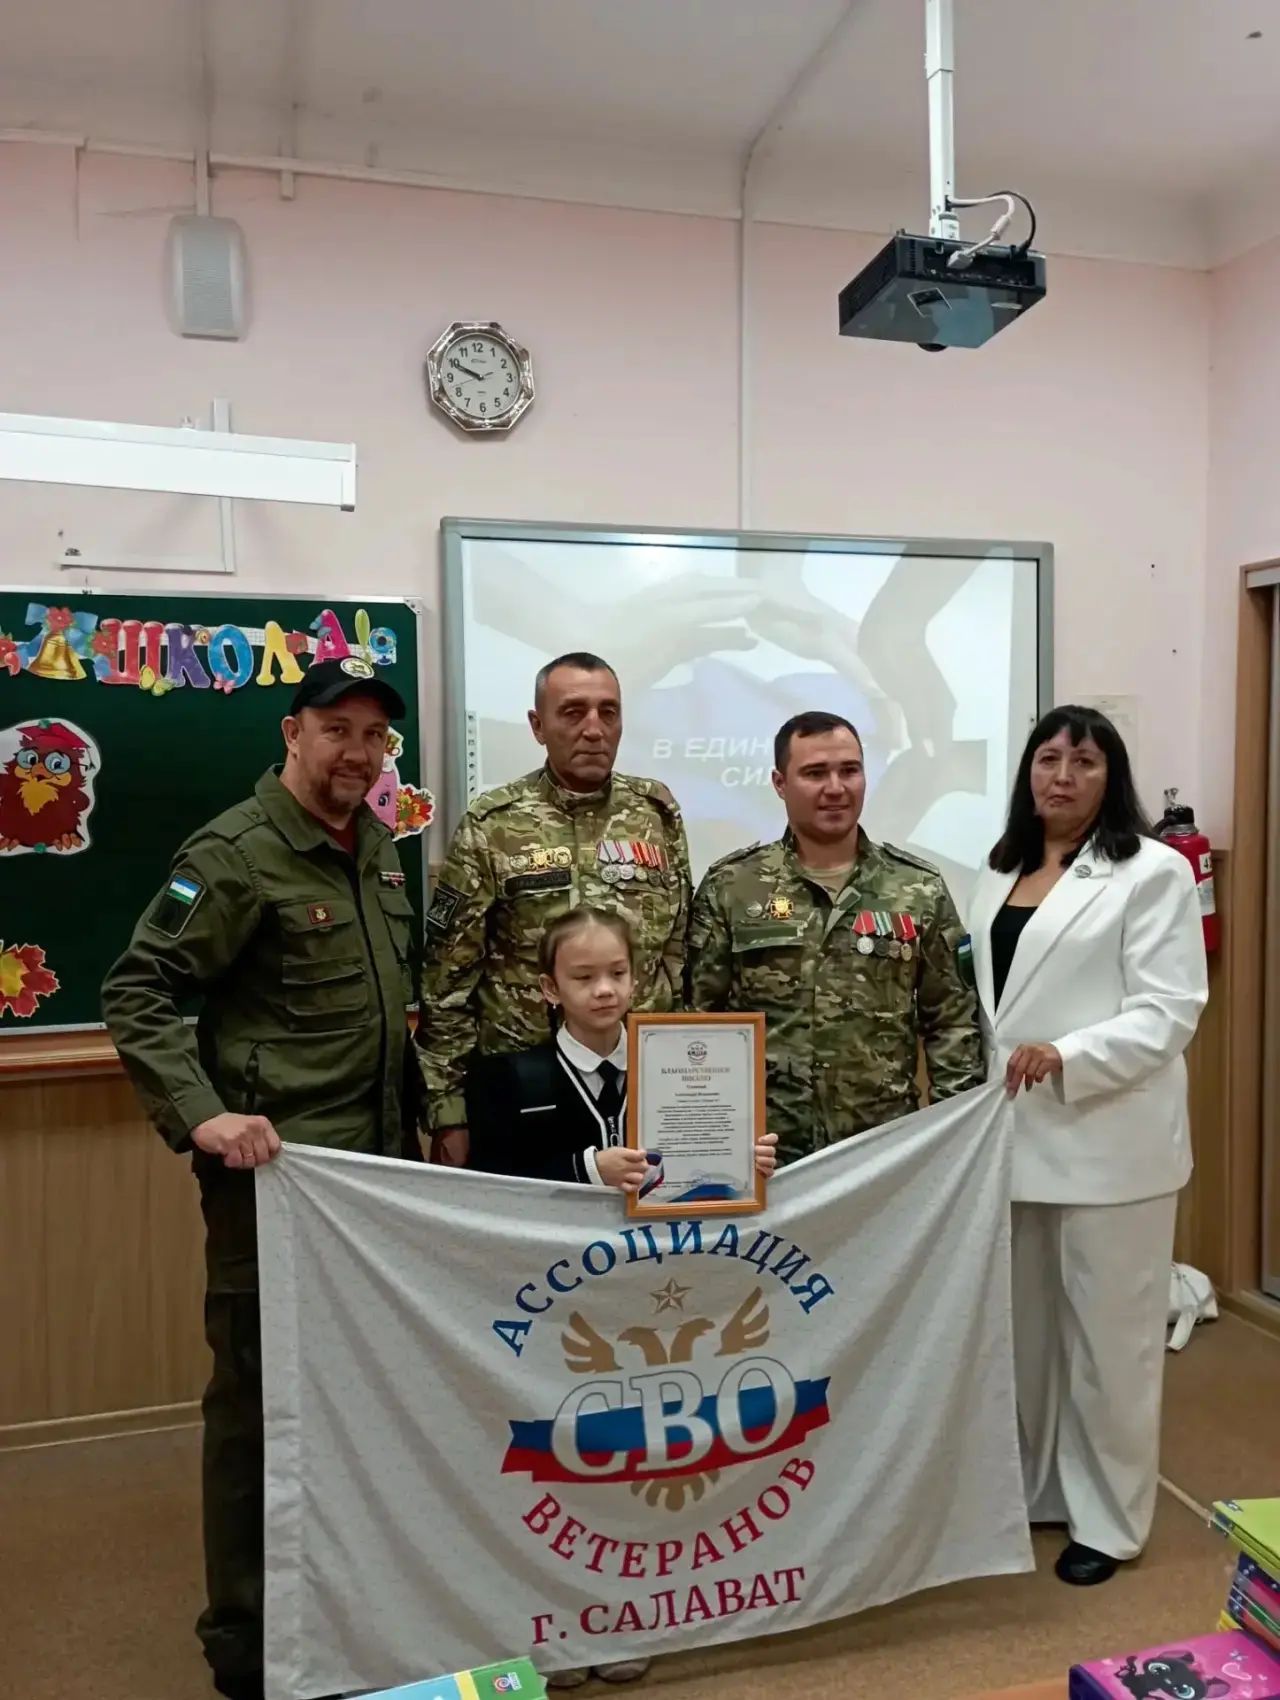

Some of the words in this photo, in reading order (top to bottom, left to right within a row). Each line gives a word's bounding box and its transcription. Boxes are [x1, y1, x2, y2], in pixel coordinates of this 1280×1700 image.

[459, 347, 468, 357] 11
[472, 342, 483, 353] 12
[490, 348, 495, 357] 1
[449, 358, 459, 368] 10
[501, 359, 507, 369] 2
[447, 373, 454, 383] 9
[507, 373, 513, 383] 3
[455, 387, 462, 397] 8
[503, 388, 510, 397] 4
[464, 398, 471, 408] 7
[480, 403, 486, 413] 6
[494, 398, 501, 408] 5
[653, 739, 673, 759] В
[684, 737, 771, 762] ЕДИН
[491, 1221, 835, 1357] АССОЦИАЦИЯ
[550, 1356, 798, 1478] СВО
[522, 1456, 816, 1578] ВЕТЕРАНОВ
[579, 1567, 805, 1635] САЛАВАТ
